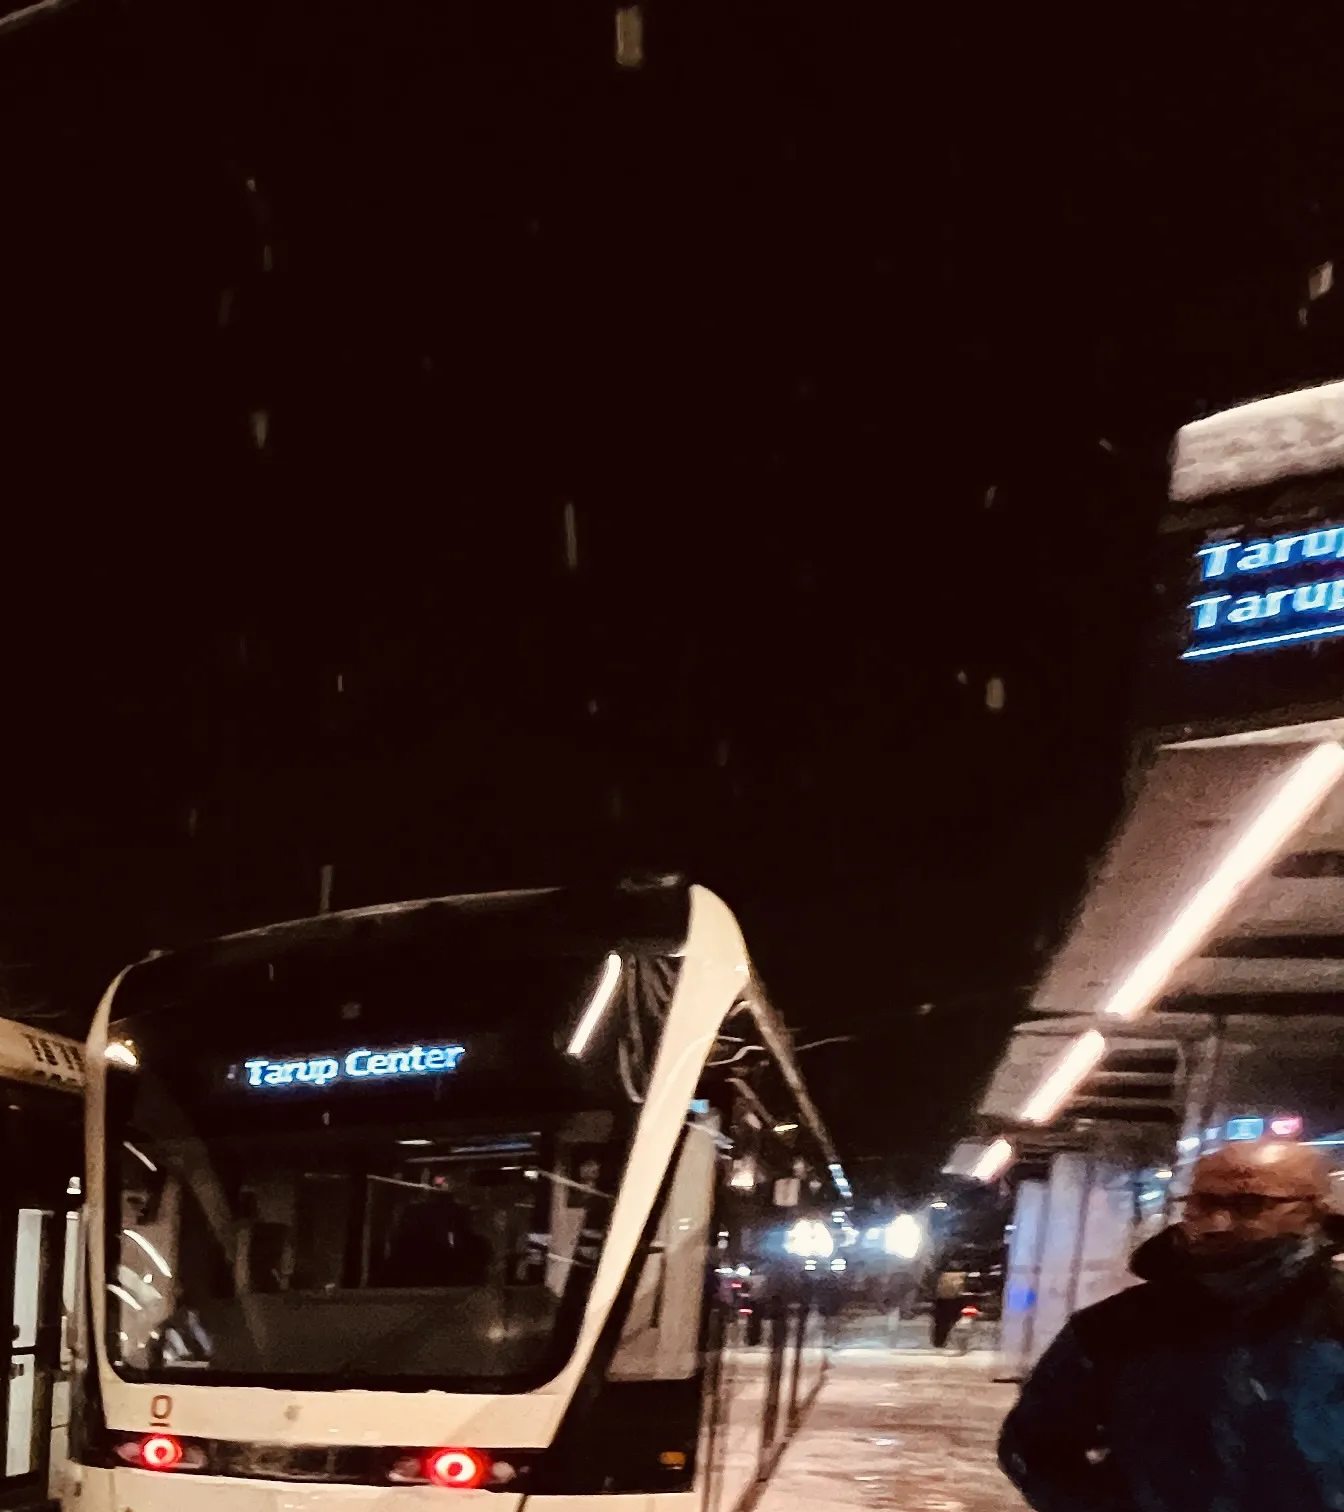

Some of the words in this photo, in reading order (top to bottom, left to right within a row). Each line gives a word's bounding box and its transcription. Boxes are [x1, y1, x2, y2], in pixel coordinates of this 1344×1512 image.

[1196, 527, 1344, 578] Taru
[244, 1057, 337, 1087] Tarup
[345, 1045, 466, 1077] Center
